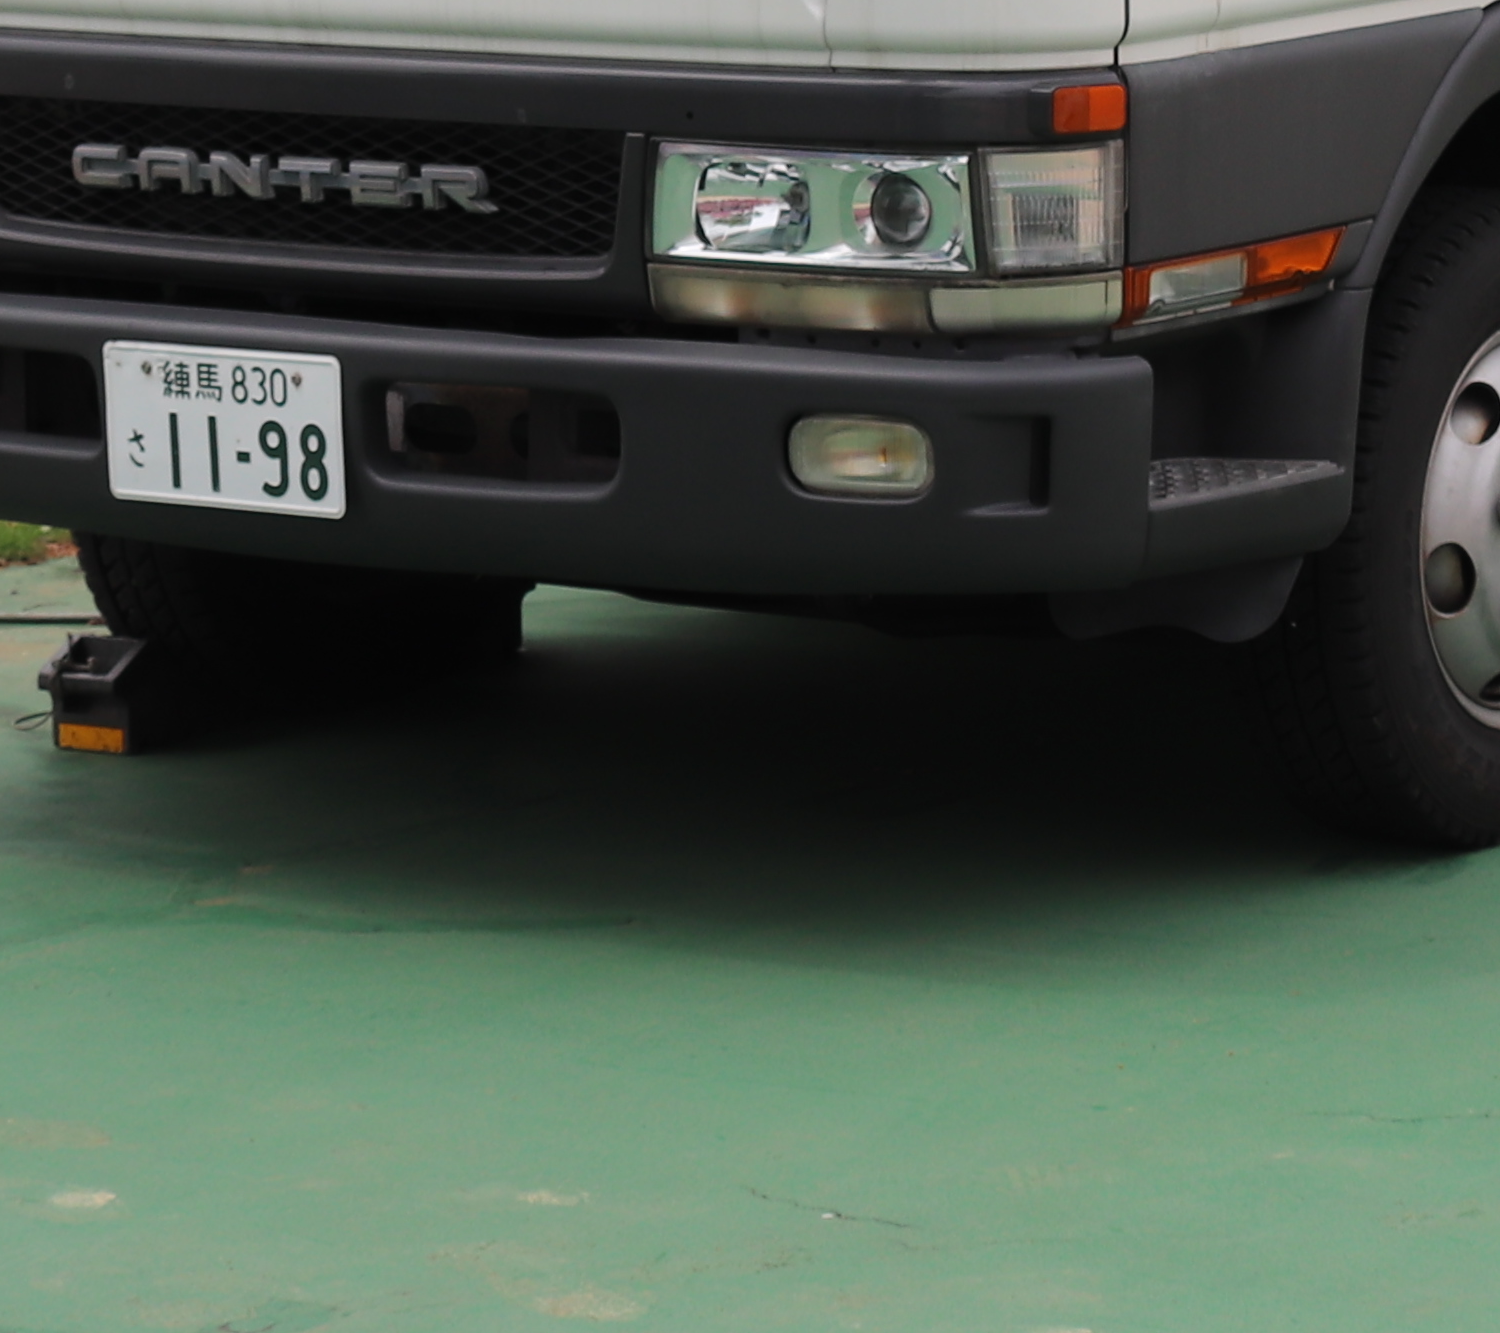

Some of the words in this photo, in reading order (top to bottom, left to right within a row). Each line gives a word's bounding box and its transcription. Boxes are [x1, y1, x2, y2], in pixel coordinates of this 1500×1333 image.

[72, 143, 499, 214] CANTER
[231, 365, 288, 407] 830
[128, 429, 146, 468] さ
[168, 412, 329, 502] 11-98
